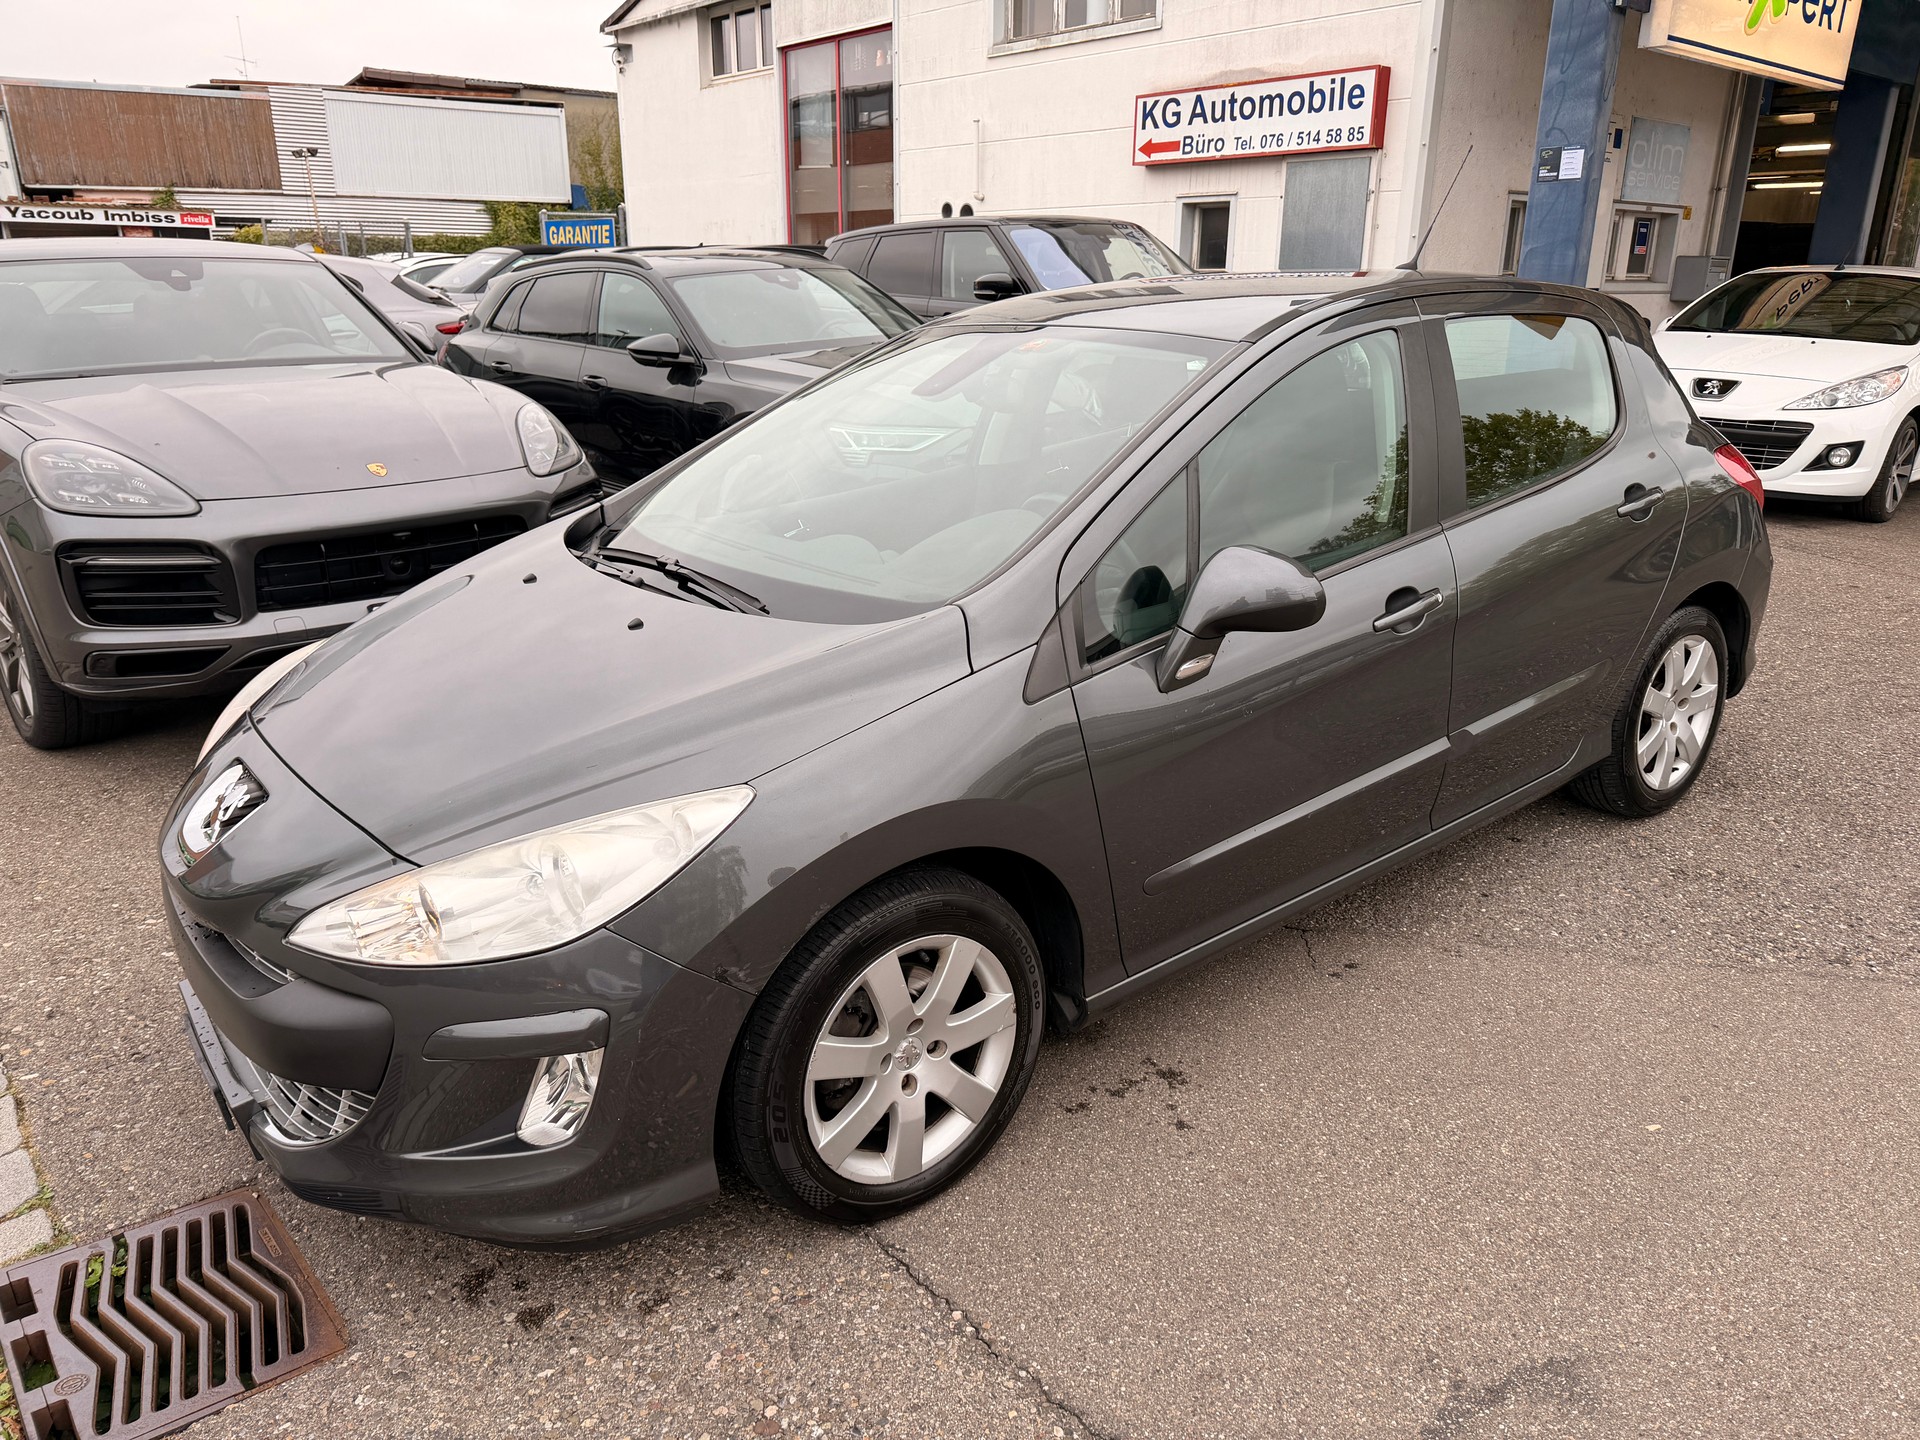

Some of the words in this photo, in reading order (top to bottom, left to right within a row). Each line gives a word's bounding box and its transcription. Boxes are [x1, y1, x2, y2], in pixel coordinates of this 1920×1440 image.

[1141, 98, 1181, 130] KG
[1188, 76, 1365, 126] Automobile
[1182, 133, 1225, 155] Büro
[1234, 136, 1255, 151] Tel.
[1260, 133, 1284, 149] 076
[1296, 130, 1321, 146] 514
[1325, 128, 1342, 144] 58
[1347, 126, 1365, 142] 85
[1631, 131, 1684, 172] clim
[1627, 170, 1680, 190] service
[5, 206, 94, 221] Yacoub
[104, 210, 176, 224] Imbiss
[183, 215, 210, 224] rivella
[549, 225, 610, 245] GARANTIE
